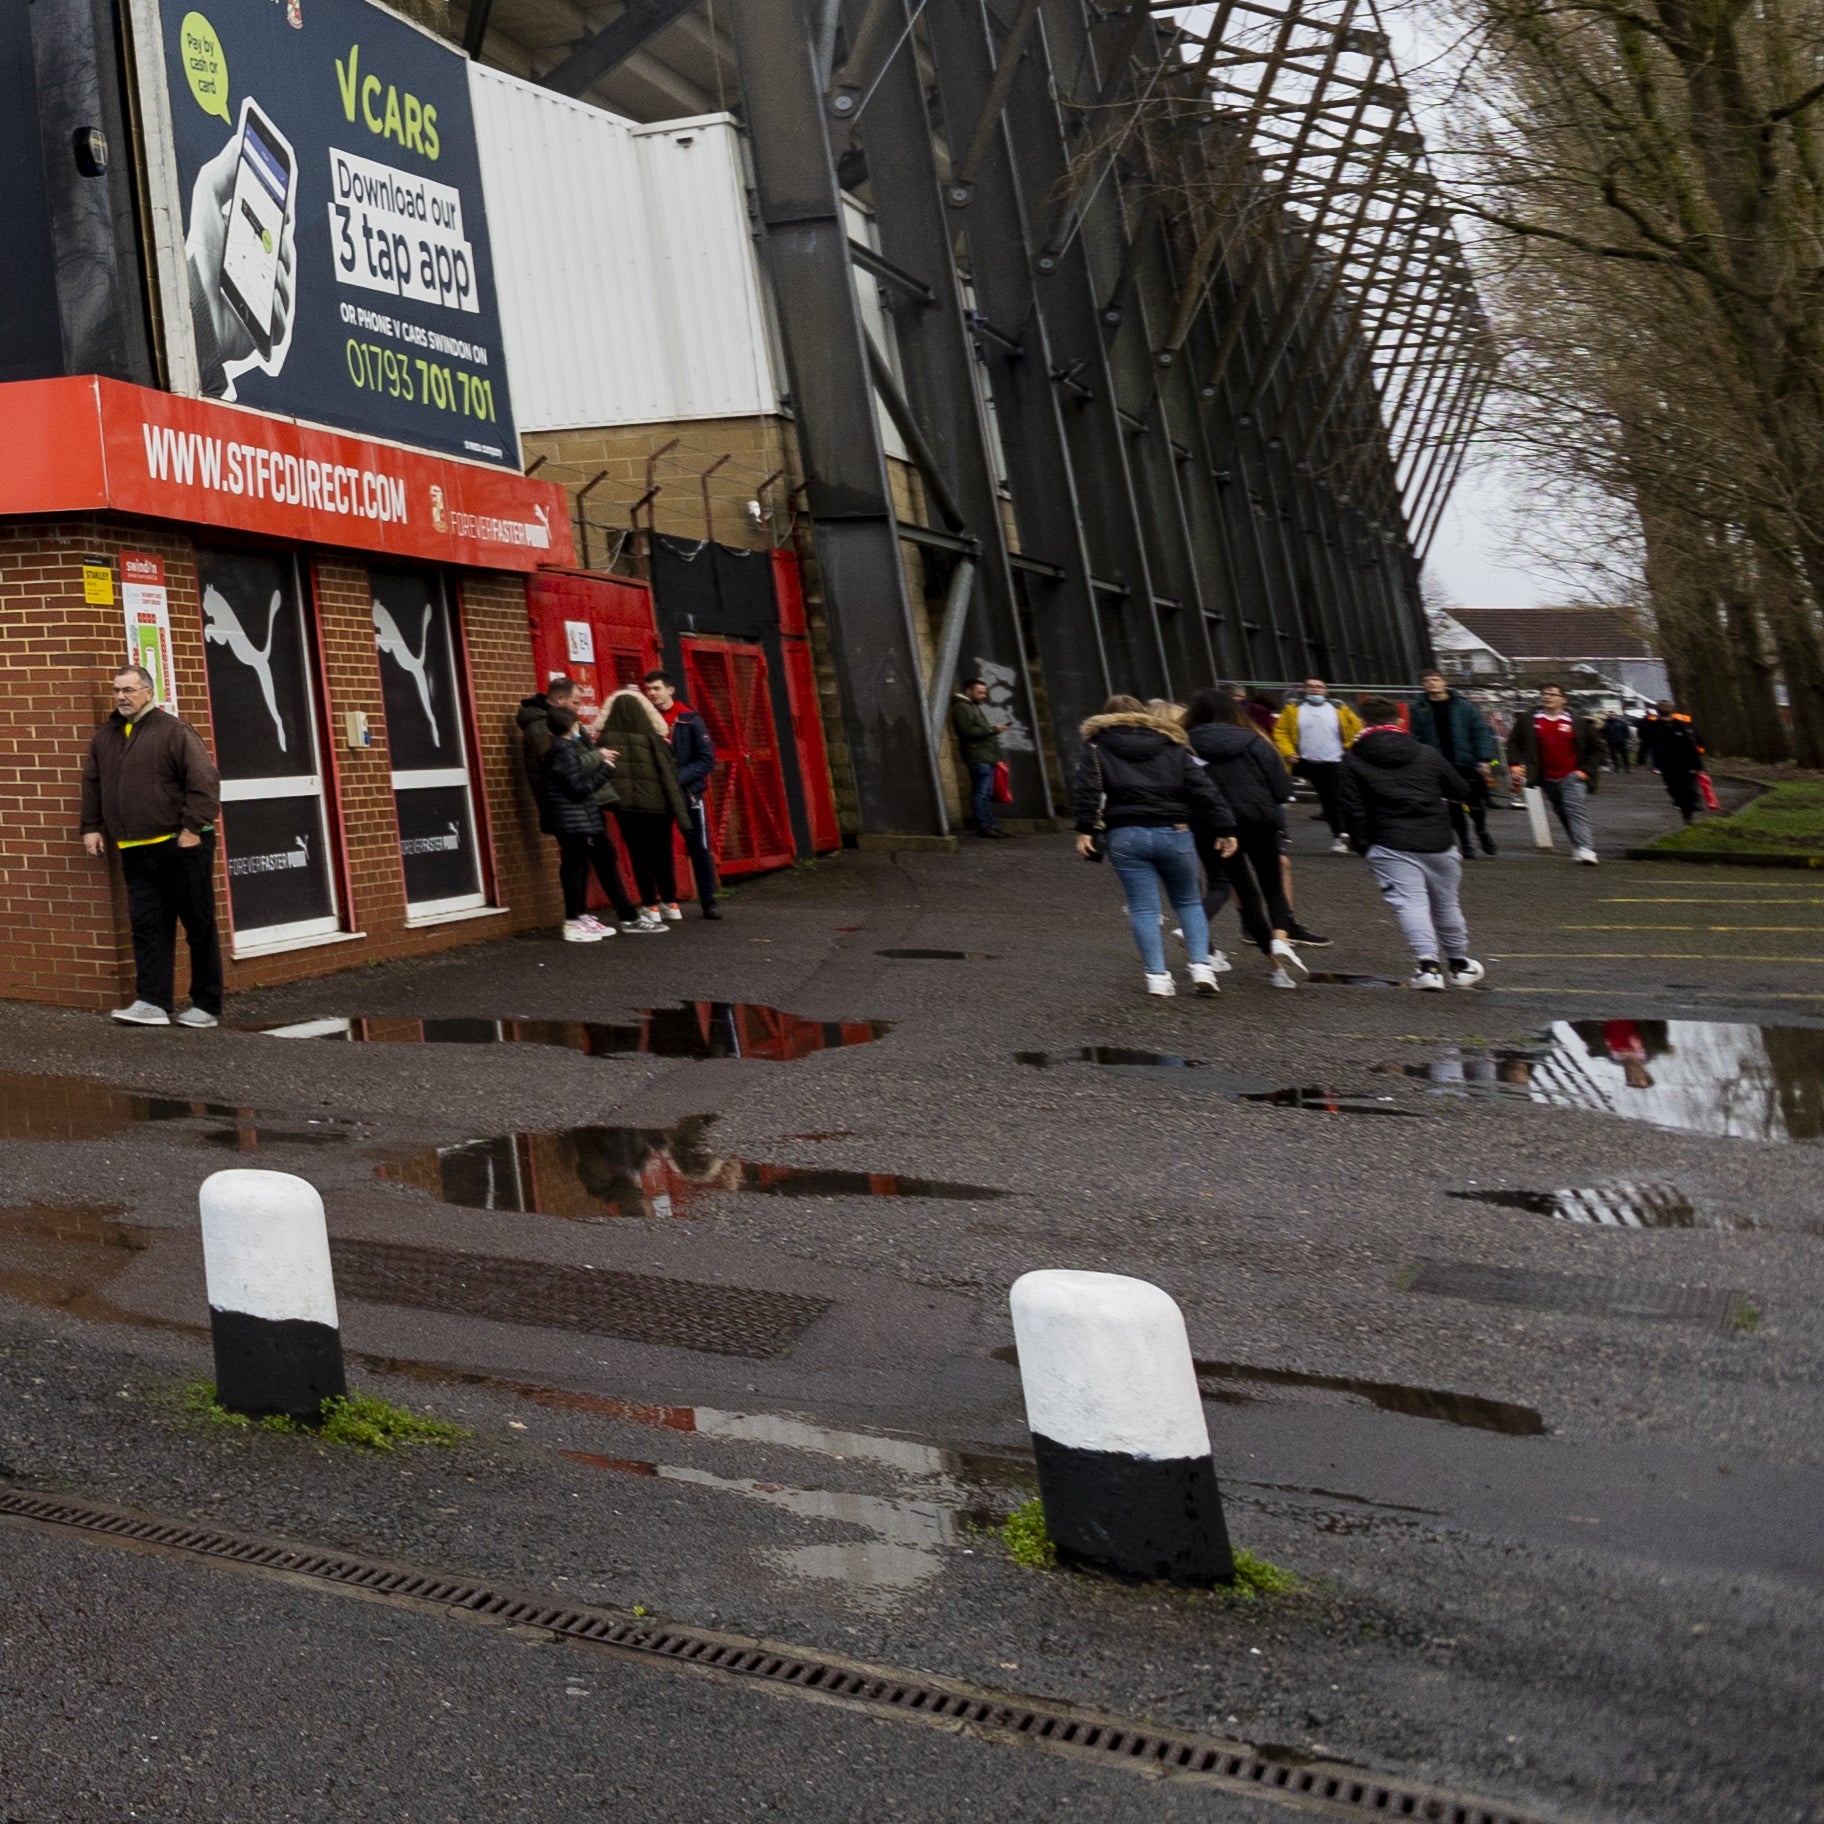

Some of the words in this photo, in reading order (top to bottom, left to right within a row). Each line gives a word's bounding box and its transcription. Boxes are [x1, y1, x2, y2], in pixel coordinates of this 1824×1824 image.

[187, 33, 201, 54] Pay
[203, 36, 214, 57] by
[190, 56, 208, 72] cash
[210, 61, 217, 73] or
[198, 78, 216, 94] card
[335, 44, 359, 122] V
[362, 75, 440, 160] CARS
[337, 158, 427, 222] Download
[432, 197, 456, 230] our
[335, 203, 355, 272] 3
[363, 213, 411, 295] tap
[419, 240, 469, 310] app
[340, 302, 357, 325] OR
[357, 307, 393, 336] PHONE
[393, 319, 400, 338] V
[402, 323, 428, 347] CARS
[428, 331, 472, 360] SWINDON
[472, 345, 488, 365] ON
[346, 339, 414, 401] 01793
[415, 359, 457, 412] 701
[457, 371, 496, 422] 701
[143, 423, 408, 525] WWW.STFCDIRECT.COM
[126, 558, 158, 574] swindn
